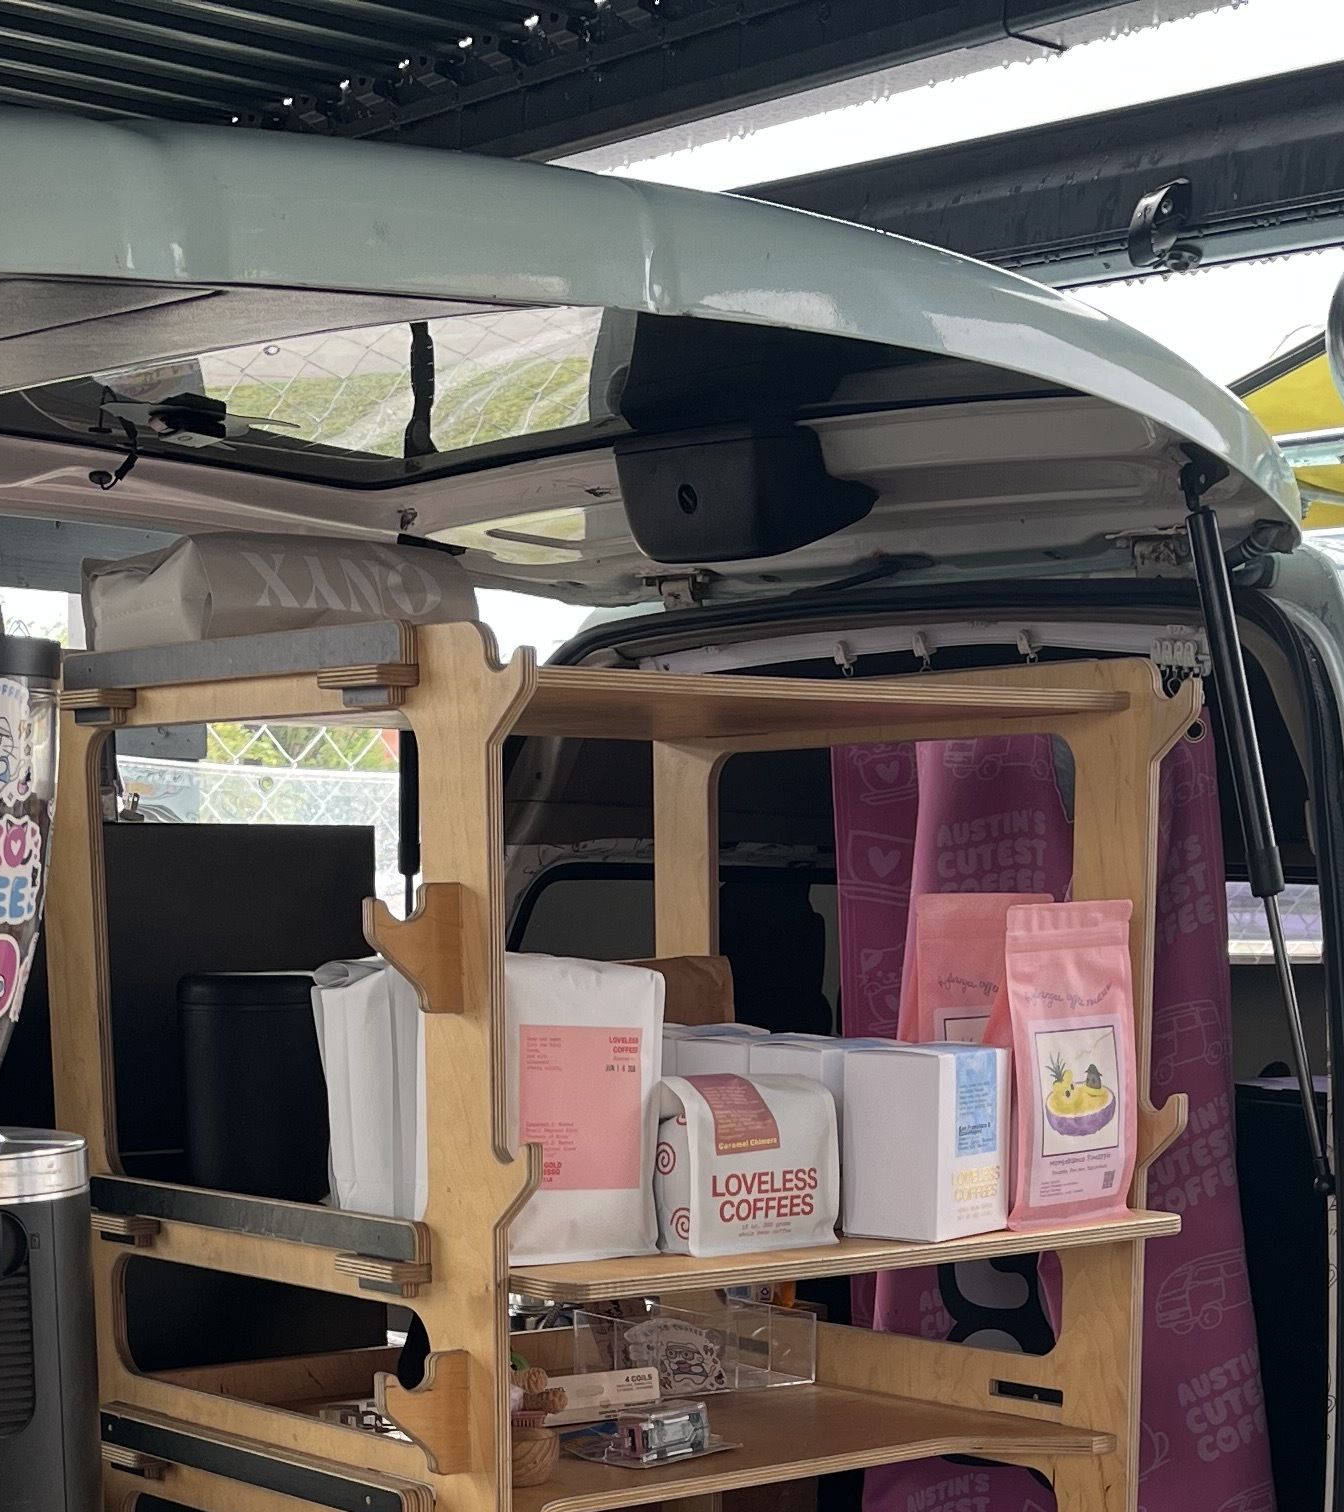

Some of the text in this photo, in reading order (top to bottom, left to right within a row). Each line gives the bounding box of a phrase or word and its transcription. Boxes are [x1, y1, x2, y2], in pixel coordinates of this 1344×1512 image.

[240, 551, 442, 617] ONYX
[936, 807, 1046, 848] AUSTIN'S
[936, 837, 1047, 879] CUTEST
[1159, 862, 1207, 912] EST
[1158, 893, 1216, 945] FEE
[711, 1167, 818, 1198] LOVELESS
[719, 1193, 815, 1223] COFFEES
